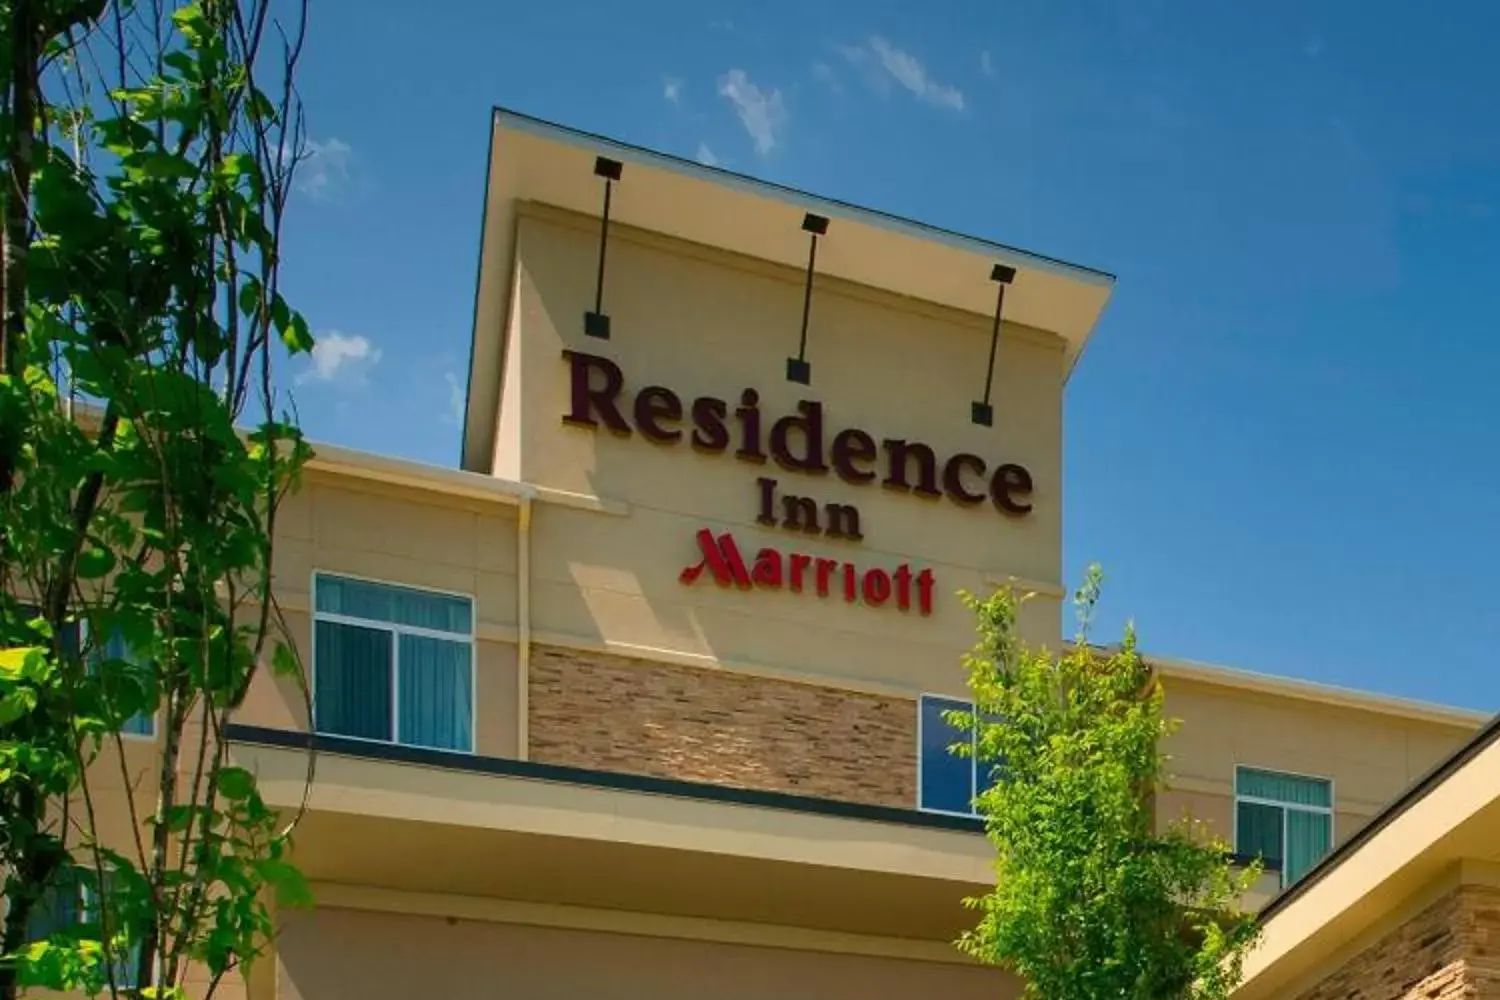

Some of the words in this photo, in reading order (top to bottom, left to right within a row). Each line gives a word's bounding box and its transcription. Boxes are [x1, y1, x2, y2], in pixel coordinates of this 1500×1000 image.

[562, 350, 1034, 516] Residence
[756, 477, 863, 540] Inn
[679, 528, 936, 615] Marriott
